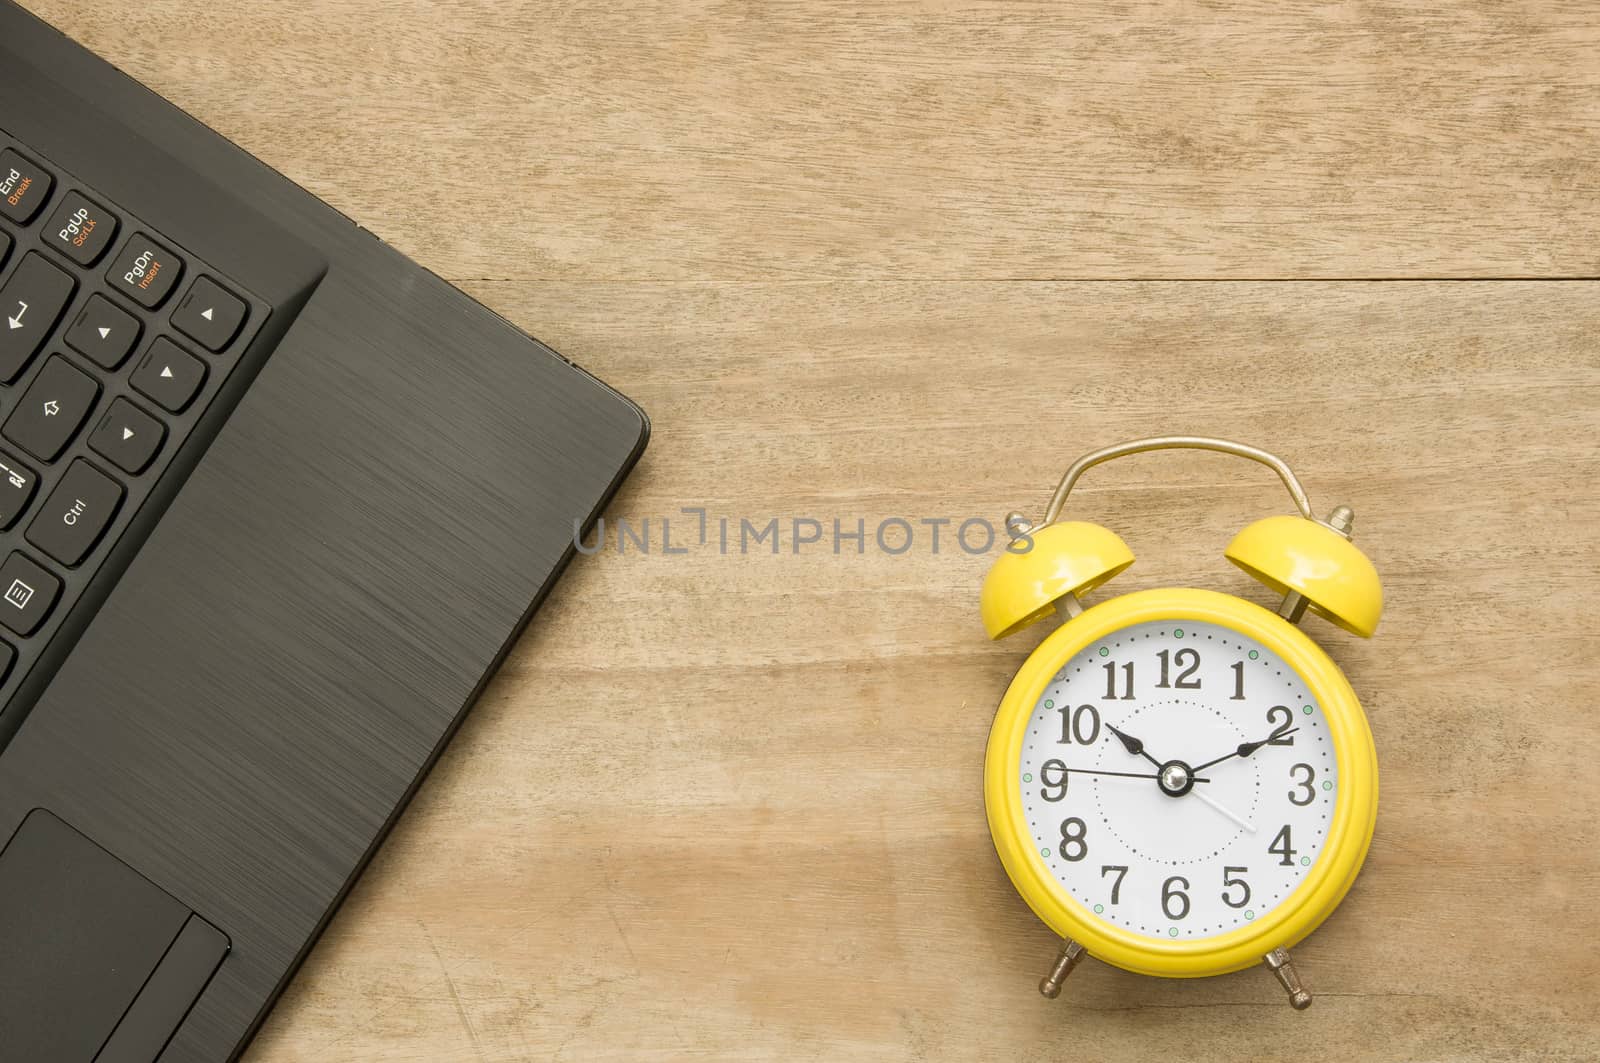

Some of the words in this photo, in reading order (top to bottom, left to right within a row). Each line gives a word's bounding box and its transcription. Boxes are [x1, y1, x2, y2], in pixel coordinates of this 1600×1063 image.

[0, 168, 20, 196] End
[8, 178, 32, 205] Break
[59, 208, 88, 241] PgUp
[73, 219, 96, 246] ScrLk
[124, 250, 153, 284] PgDn
[138, 262, 161, 289] Insert
[63, 499, 86, 526] Ctrl
[1101, 661, 1136, 700] 11
[1155, 648, 1201, 689] 12
[1230, 661, 1246, 700] 1
[1056, 704, 1101, 746] 10
[1266, 705, 1294, 746] 2
[1040, 759, 1069, 802] 9
[1287, 763, 1316, 806] 3
[1058, 816, 1088, 862] 8
[1268, 824, 1297, 866] 4
[1101, 865, 1129, 905] 7
[1161, 876, 1191, 921] 6
[1221, 866, 1251, 909] 5
